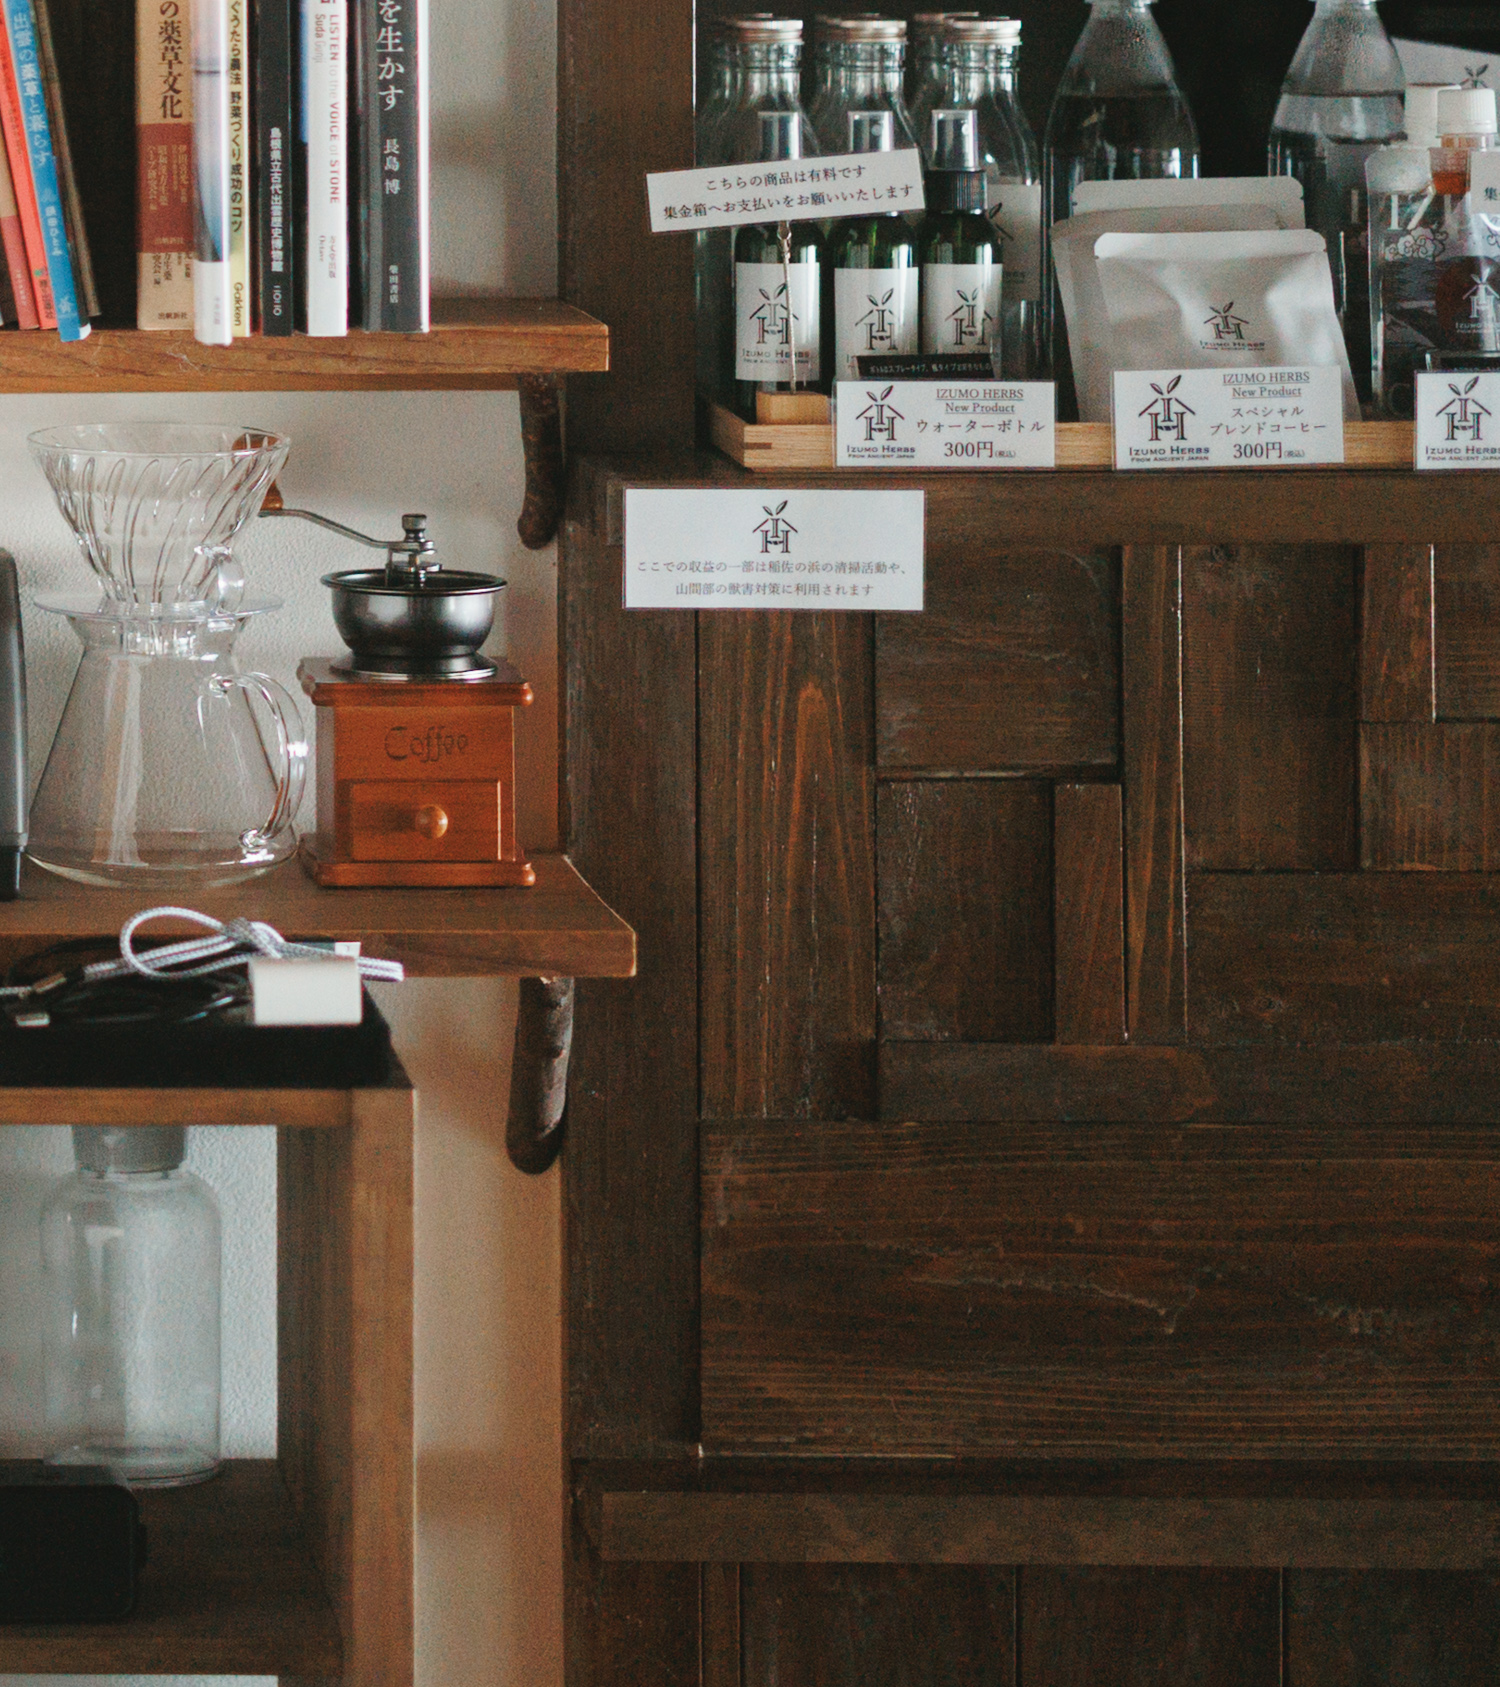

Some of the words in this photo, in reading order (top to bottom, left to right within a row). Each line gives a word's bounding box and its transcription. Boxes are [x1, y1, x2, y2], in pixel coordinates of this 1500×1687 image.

[315, 14, 326, 39] Suda
[329, 14, 340, 61] LISTEN
[329, 101, 340, 142] VOICE
[329, 159, 340, 204] STONE
[706, 164, 867, 190] こちらの商品は有料です
[663, 184, 914, 220] 集金箱へお支払いをお願いいたします
[233, 281, 244, 327] Gakken
[1222, 373, 1266, 384] IZUMO
[1269, 371, 1310, 382] HERBS
[936, 388, 979, 399] IZUMO
[983, 388, 1024, 399] HERBS
[1232, 387, 1258, 398] New
[1260, 385, 1302, 396] Product
[944, 402, 969, 412] New
[972, 402, 1015, 412] Product
[1230, 406, 1304, 418] スペシャル
[916, 419, 1046, 433] ウォーターボトル
[1210, 422, 1327, 436] ブレンドコーヒー
[846, 445, 878, 453] IZUMO
[882, 444, 916, 453] HERBS
[944, 440, 994, 458] 300円
[1129, 447, 1166, 456] IZUMO
[1170, 446, 1210, 455] HERBS
[1232, 441, 1282, 459] 300円
[1425, 445, 1462, 455] IZUMO
[637, 560, 907, 574] ここでの収益の一部は稲佐の浜の清掃活動や、
[675, 582, 874, 596] 山間部の獣害対策に利用されます
[384, 724, 470, 763] Coffee
